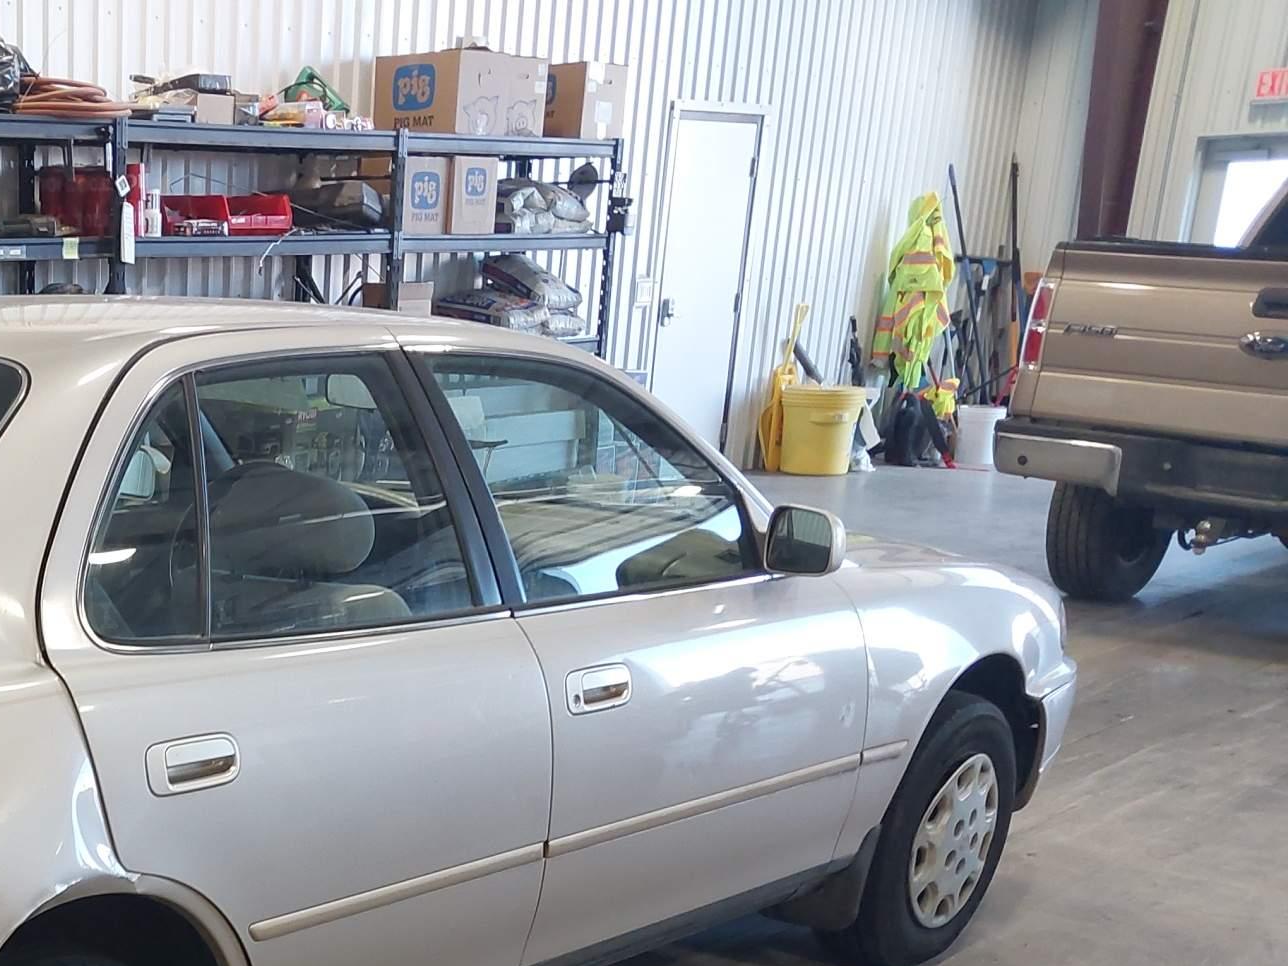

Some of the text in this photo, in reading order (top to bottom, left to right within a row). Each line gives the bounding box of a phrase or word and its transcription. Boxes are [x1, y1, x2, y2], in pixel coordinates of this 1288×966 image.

[397, 69, 431, 105] pig
[1256, 71, 1288, 97] EXI
[394, 115, 434, 128] PIG MAT
[414, 175, 437, 205] pig
[466, 170, 485, 194] pig
[424, 212, 439, 222] MAT
